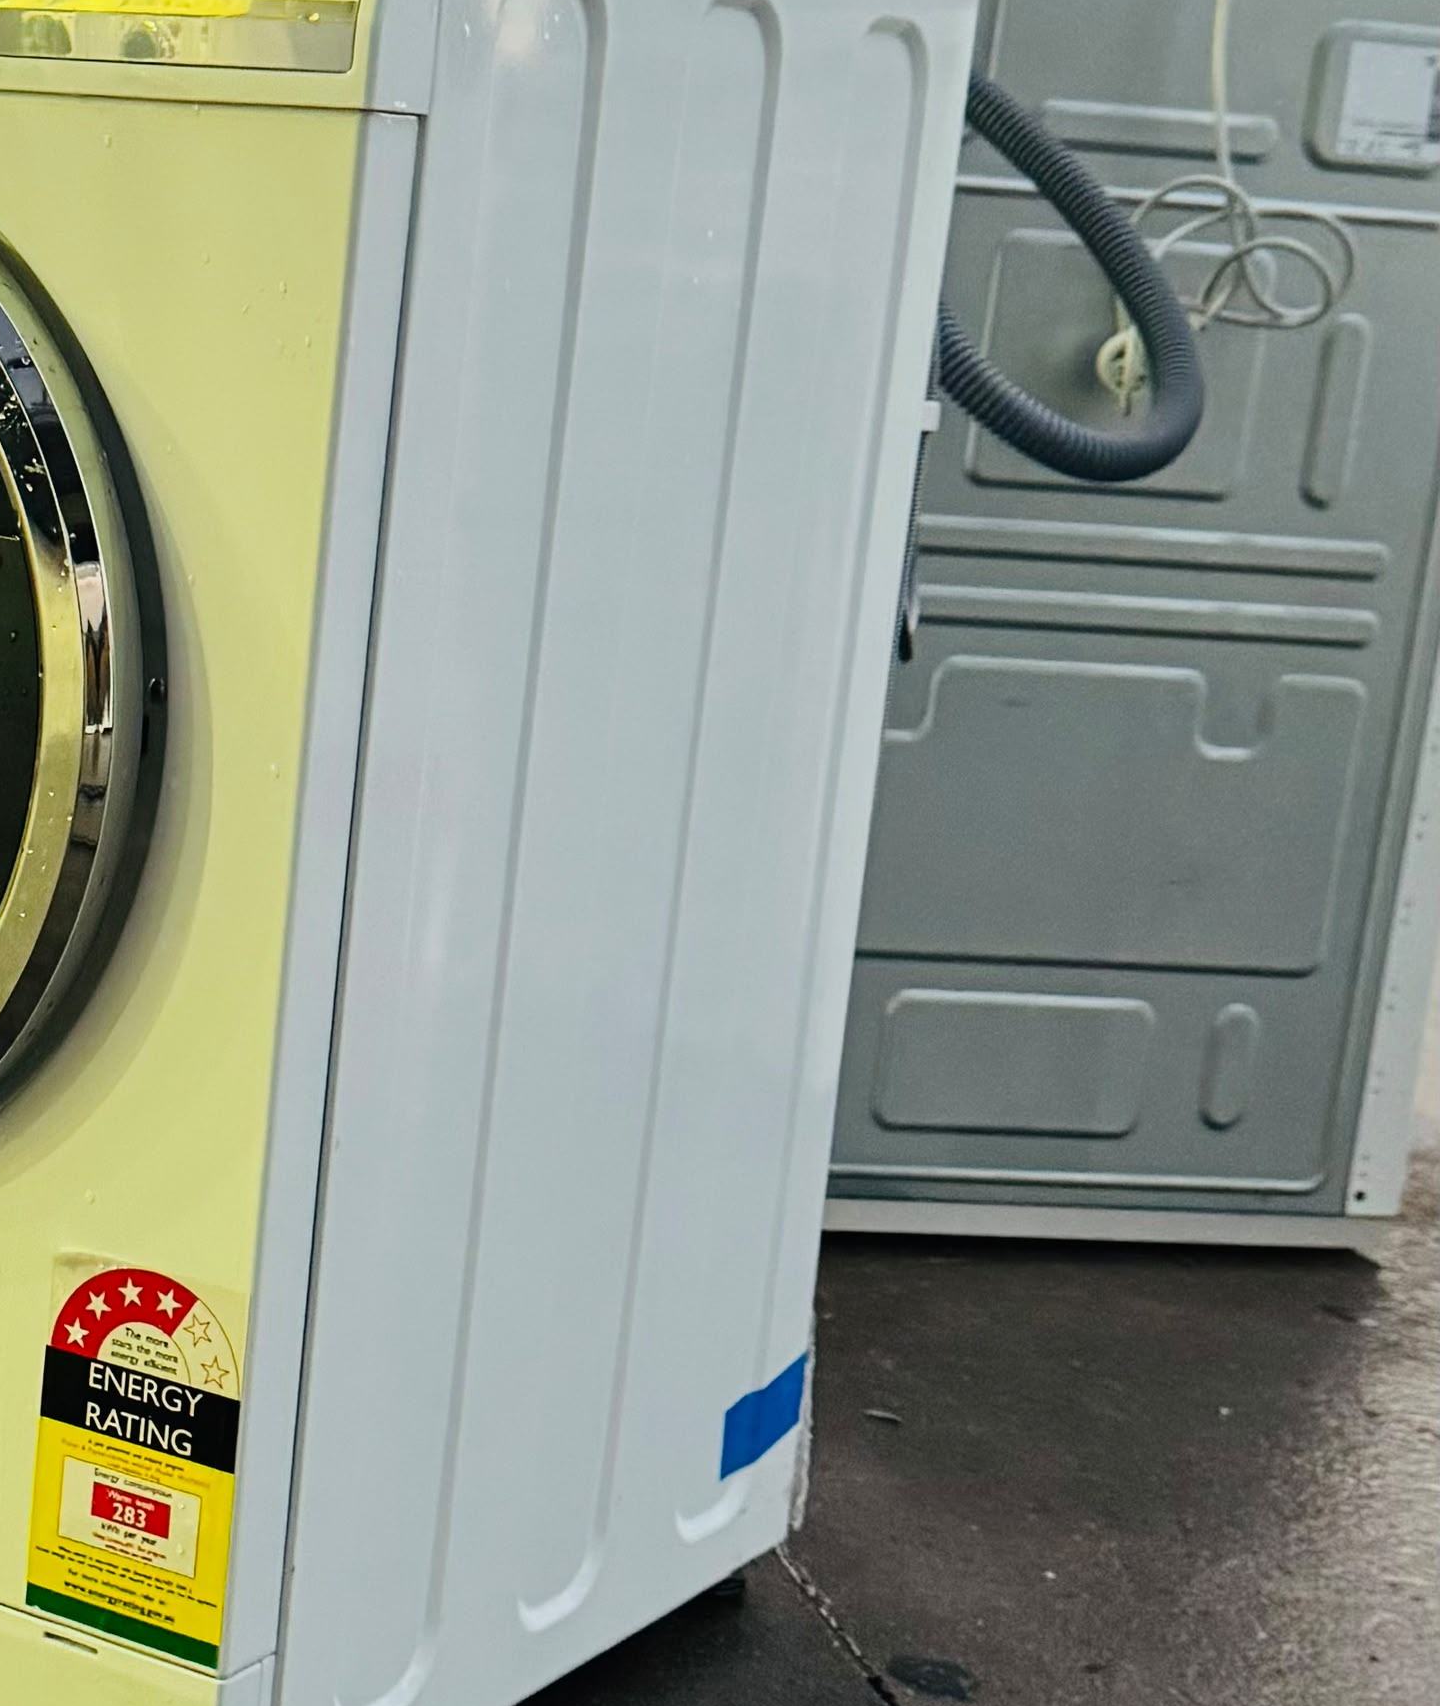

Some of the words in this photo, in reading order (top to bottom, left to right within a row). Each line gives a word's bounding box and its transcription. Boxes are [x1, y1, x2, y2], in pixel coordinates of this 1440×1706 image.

[125, 1326, 142, 1341] The
[146, 1335, 169, 1349] more
[88, 1361, 204, 1418] ENERGY
[85, 1401, 193, 1457] RATING
[94, 1467, 120, 1484] Energy
[112, 1501, 148, 1530] 283
